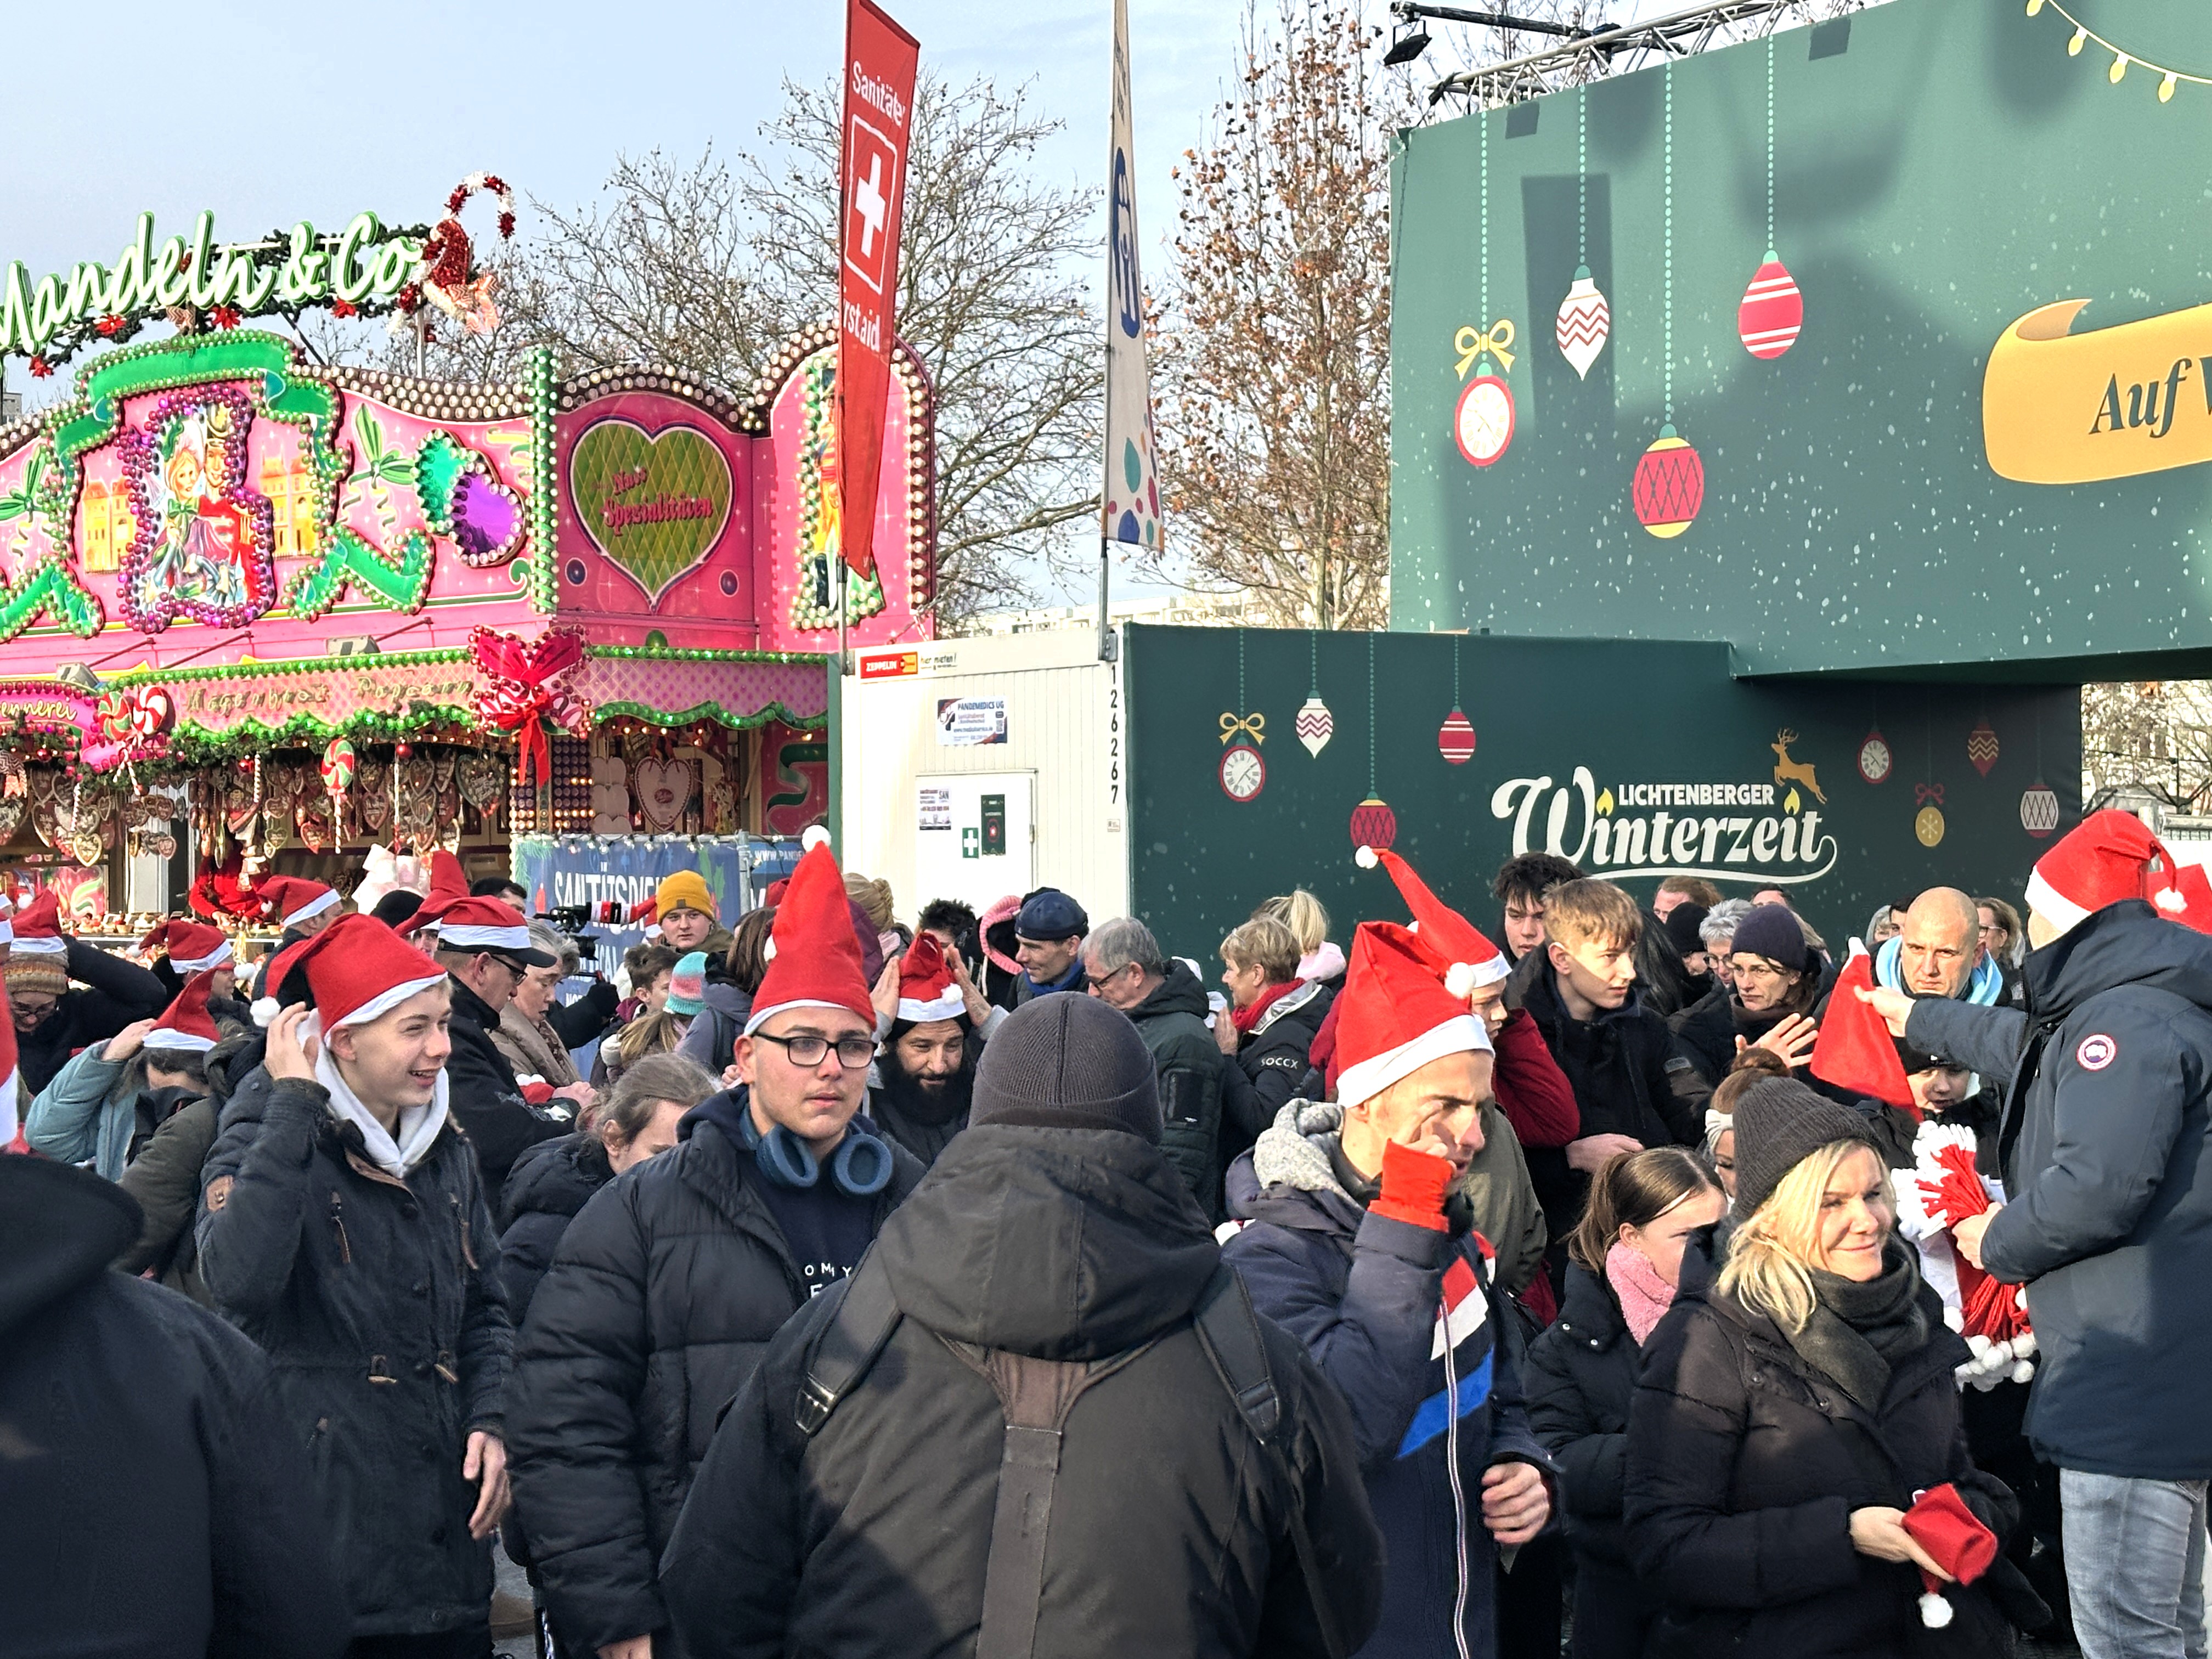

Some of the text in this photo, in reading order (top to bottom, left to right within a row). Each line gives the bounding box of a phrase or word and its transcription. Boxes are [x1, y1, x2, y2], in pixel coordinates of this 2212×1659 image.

[860, 308, 880, 352] aid
[2089, 358, 2192, 438] Auf
[599, 492, 714, 537] Spezialitäten
[866, 660, 898, 672] ZEPPELIN
[921, 654, 932, 664] hier
[356, 675, 474, 703] Popcorn
[0, 699, 77, 721] ennerei
[957, 701, 1005, 710] PANDEMEDICS UG
[1110, 664, 1119, 804] 126267
[1618, 784, 1775, 806] LICHTENBERGER
[1491, 766, 1837, 883] Winterzeit
[1260, 1057, 1299, 1070] SOCCX
